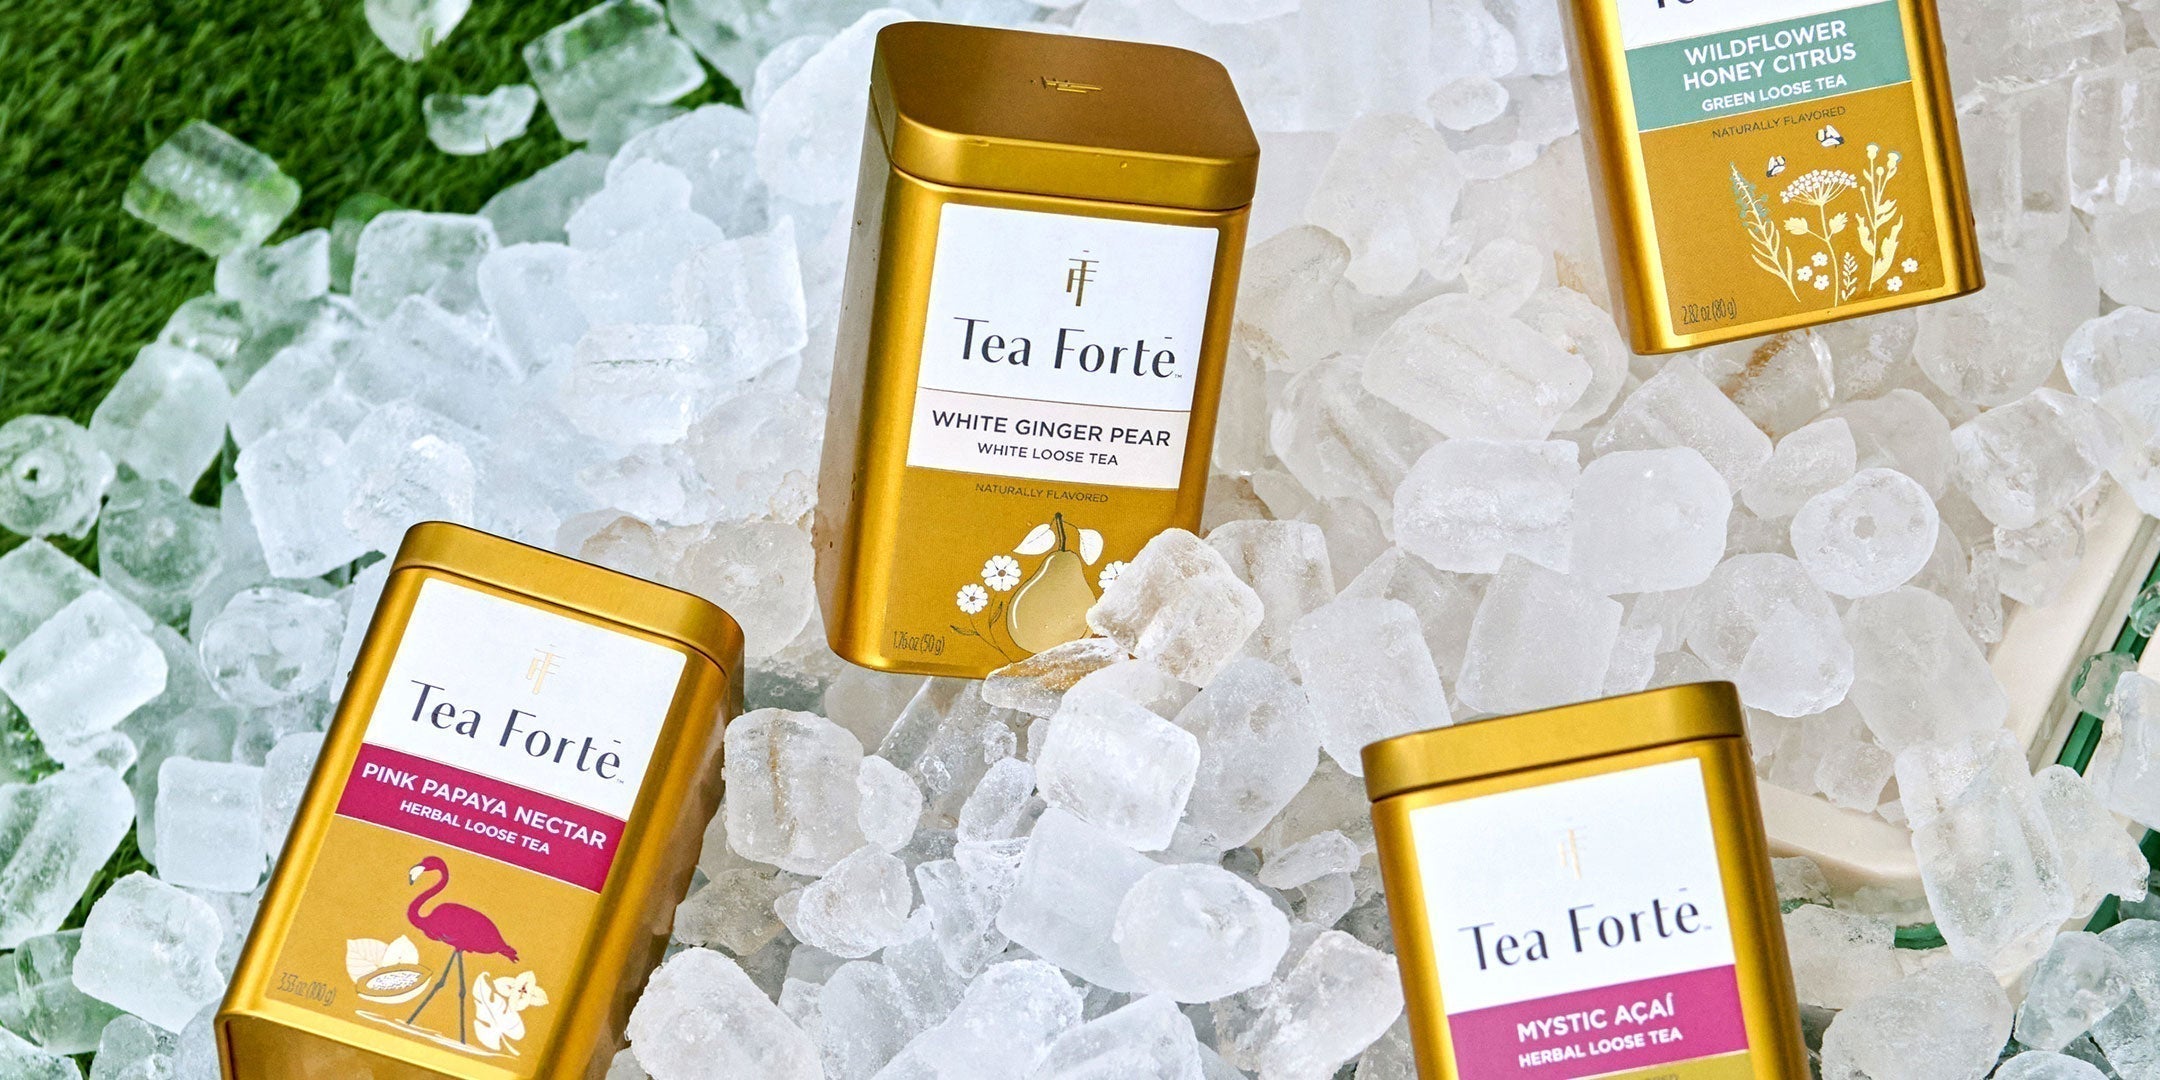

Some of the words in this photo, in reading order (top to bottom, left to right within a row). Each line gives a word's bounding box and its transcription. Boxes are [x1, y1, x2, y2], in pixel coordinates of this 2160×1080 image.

[1684, 19, 1847, 66] WILDFLOWER
[1683, 57, 1770, 92] HONEY
[1773, 42, 1857, 77] CITRUS
[1702, 90, 1756, 113] GREEN
[1759, 81, 1813, 103] LOOSE
[1815, 75, 1847, 92] TEA
[1712, 118, 1781, 140] NATURALLY
[1784, 106, 1847, 126] FLAVORED
[1682, 303, 1700, 325] 2.82
[1701, 305, 1711, 321] oz
[953, 316, 1031, 368] Tea
[931, 409, 1008, 434] WHITE
[1015, 419, 1104, 442] GINGER
[1110, 427, 1171, 447] PEAR
[977, 442, 1028, 459] WHITE
[1032, 447, 1084, 463] LOOSE
[1088, 452, 1119, 466] TEA
[975, 483, 1044, 500] NATURALLY
[1046, 489, 1109, 504] FLAVORED
[909, 636, 920, 651] oz
[410, 679, 482, 739] Tea
[361, 762, 419, 791] PINK
[421, 777, 508, 818] PAPAYA
[514, 807, 607, 850] NECTAR
[400, 799, 462, 828] HERBAL
[464, 816, 518, 845] LOOSE
[521, 834, 550, 856] TEA
[1458, 921, 1549, 972] Tea
[1517, 1008, 1609, 1043] MYSTIC
[1613, 991, 1675, 1026] AÇAÍ
[1518, 1045, 1588, 1069] HERBAL
[1588, 1033, 1645, 1056] LOOSE
[1648, 1026, 1684, 1046] TEA
